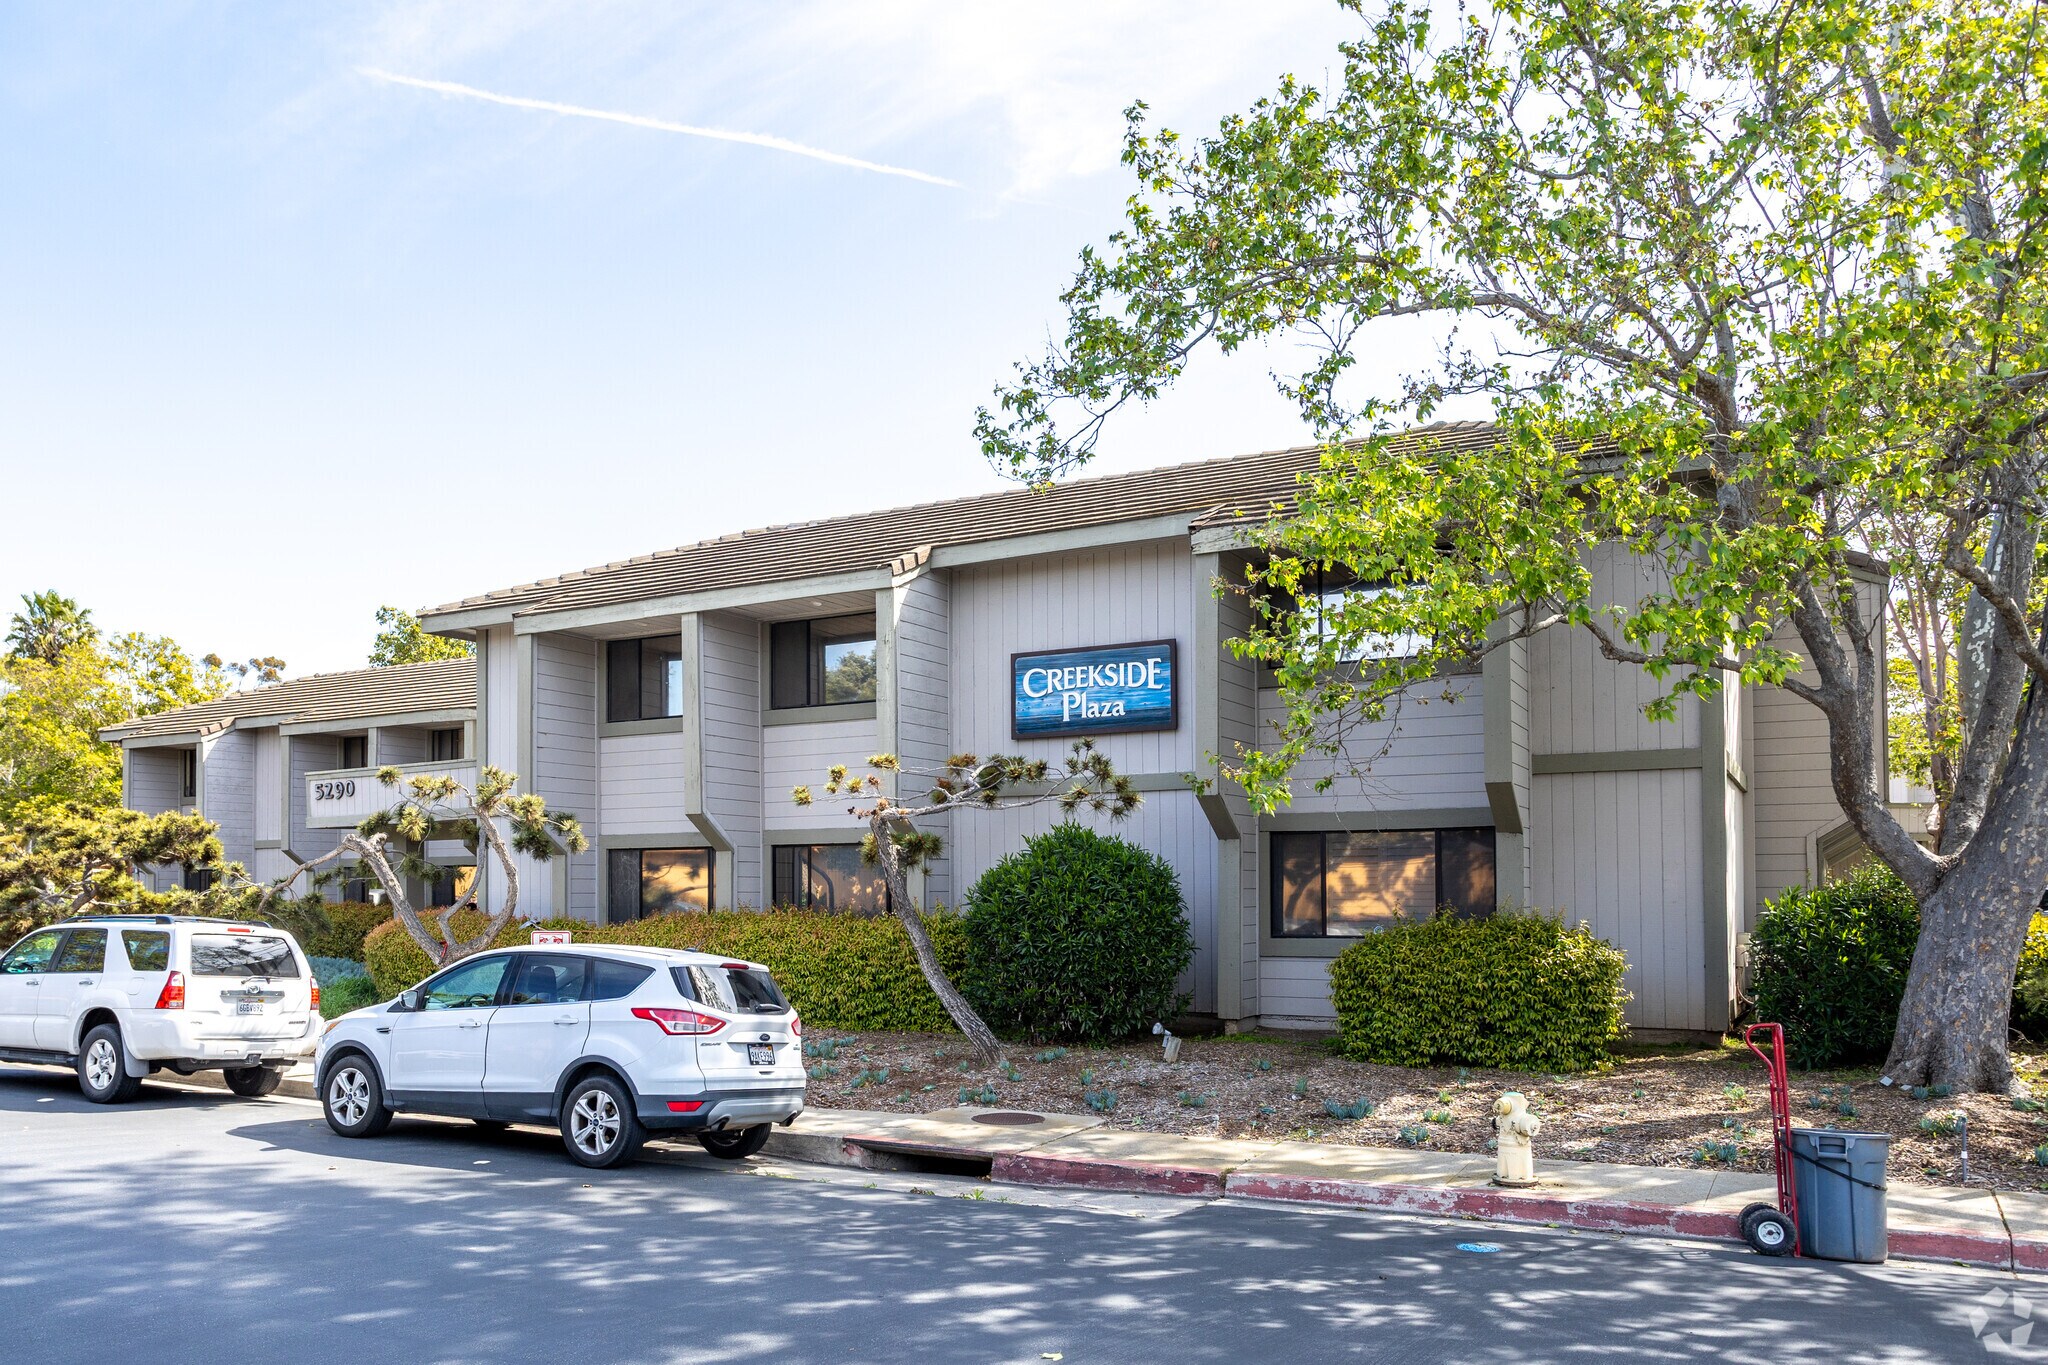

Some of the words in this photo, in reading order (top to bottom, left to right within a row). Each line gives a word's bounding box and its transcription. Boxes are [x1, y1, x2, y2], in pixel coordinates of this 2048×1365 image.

[1022, 657, 1164, 698] CREEKSIDE
[1062, 691, 1126, 722] Plaza
[315, 780, 355, 801] 5290
